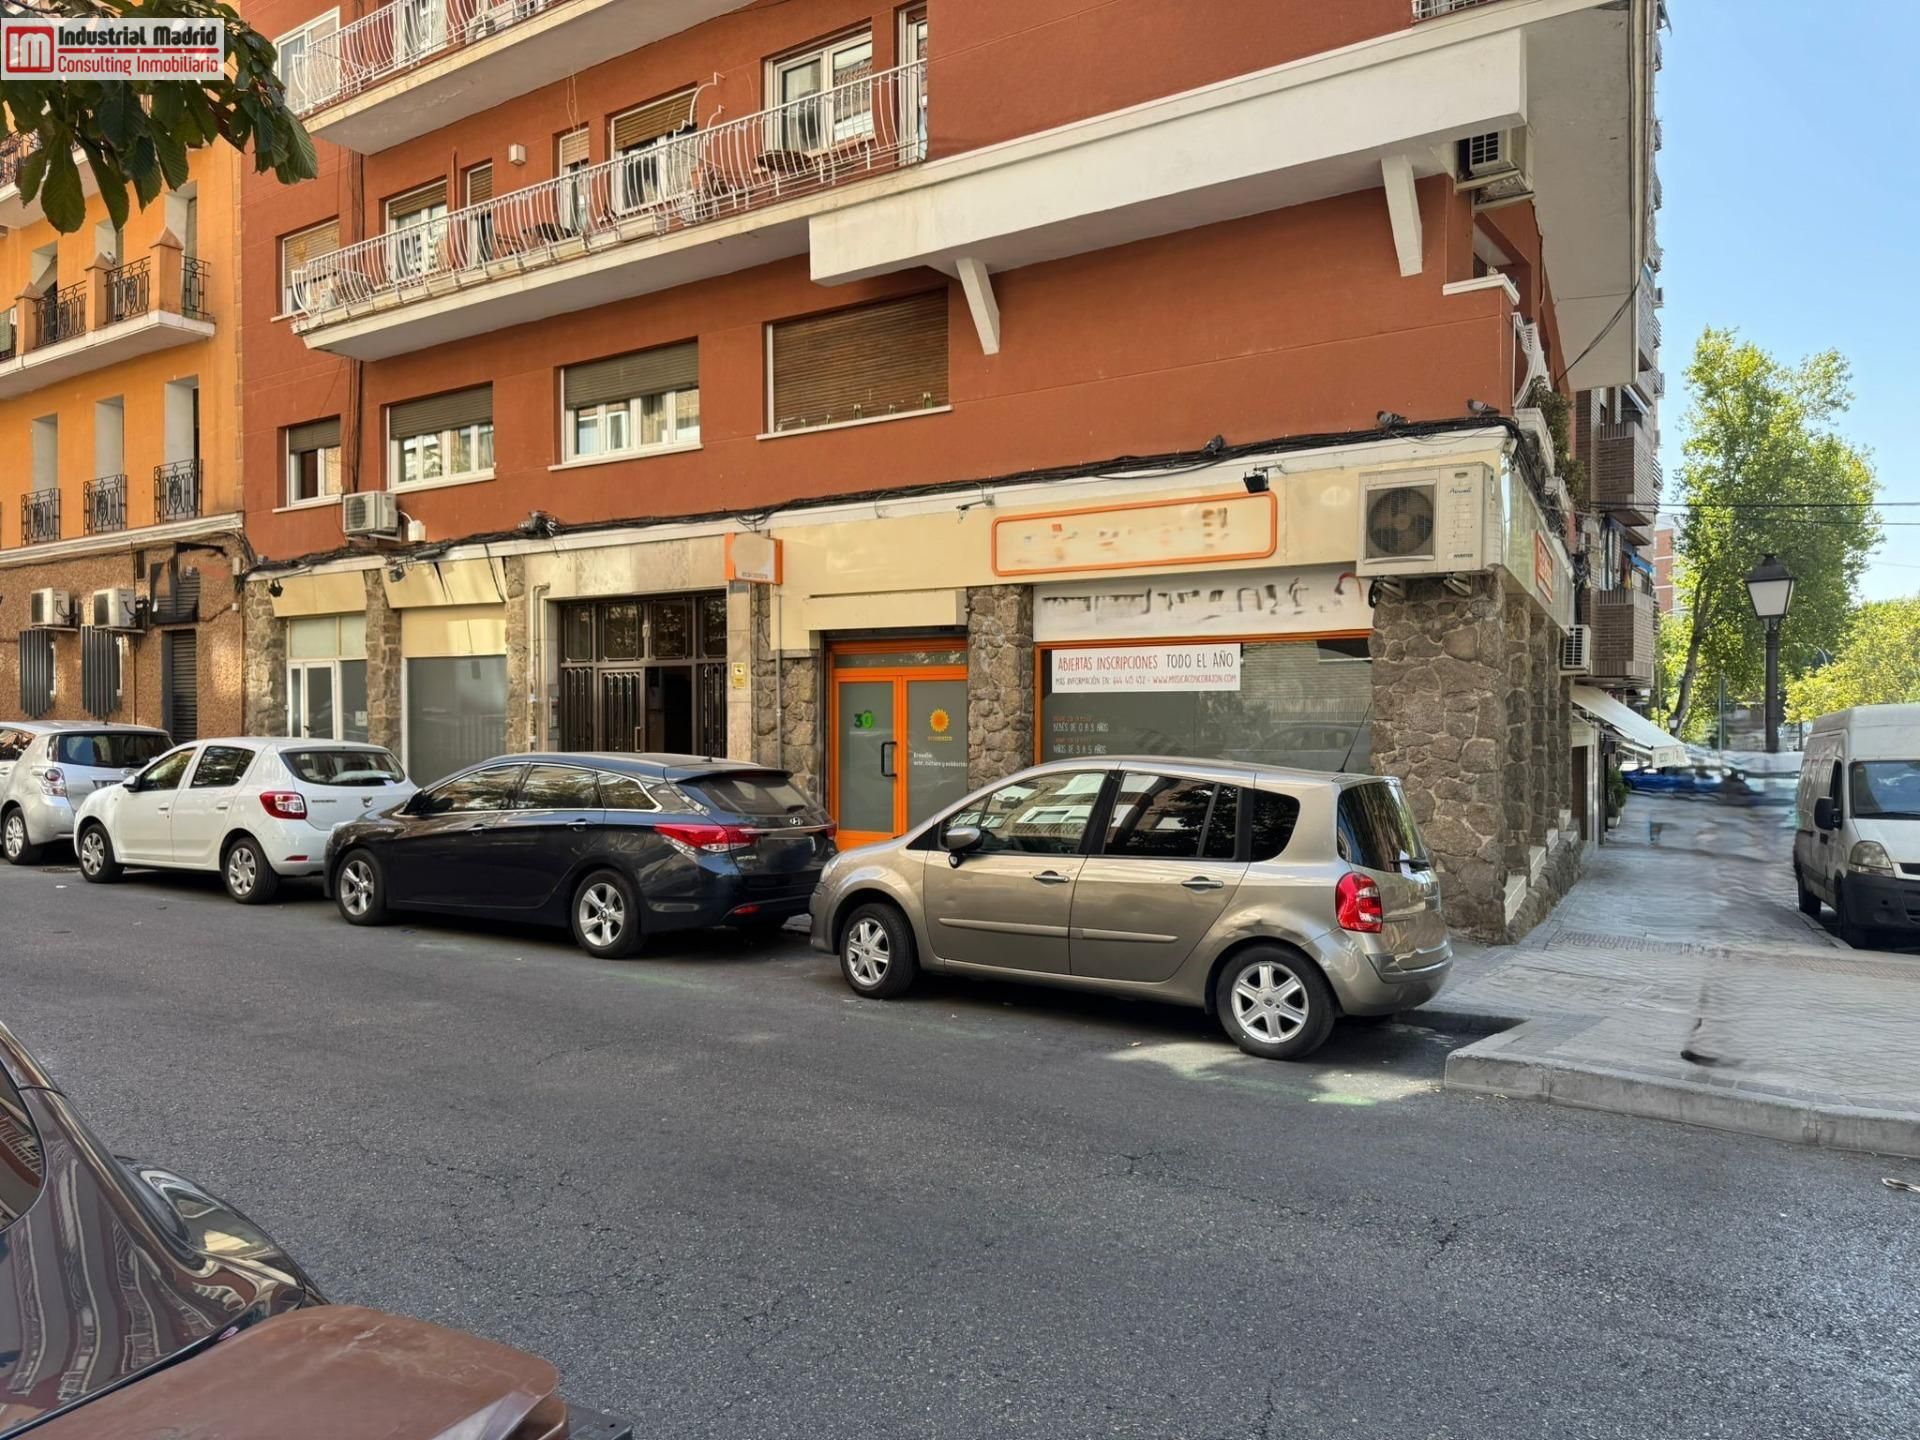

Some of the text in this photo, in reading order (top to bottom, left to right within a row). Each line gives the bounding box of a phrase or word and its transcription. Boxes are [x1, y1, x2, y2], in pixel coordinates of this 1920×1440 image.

[1057, 649, 1234, 672] ABIERTAS INSCRIPCIONES TODO EL AÑO
